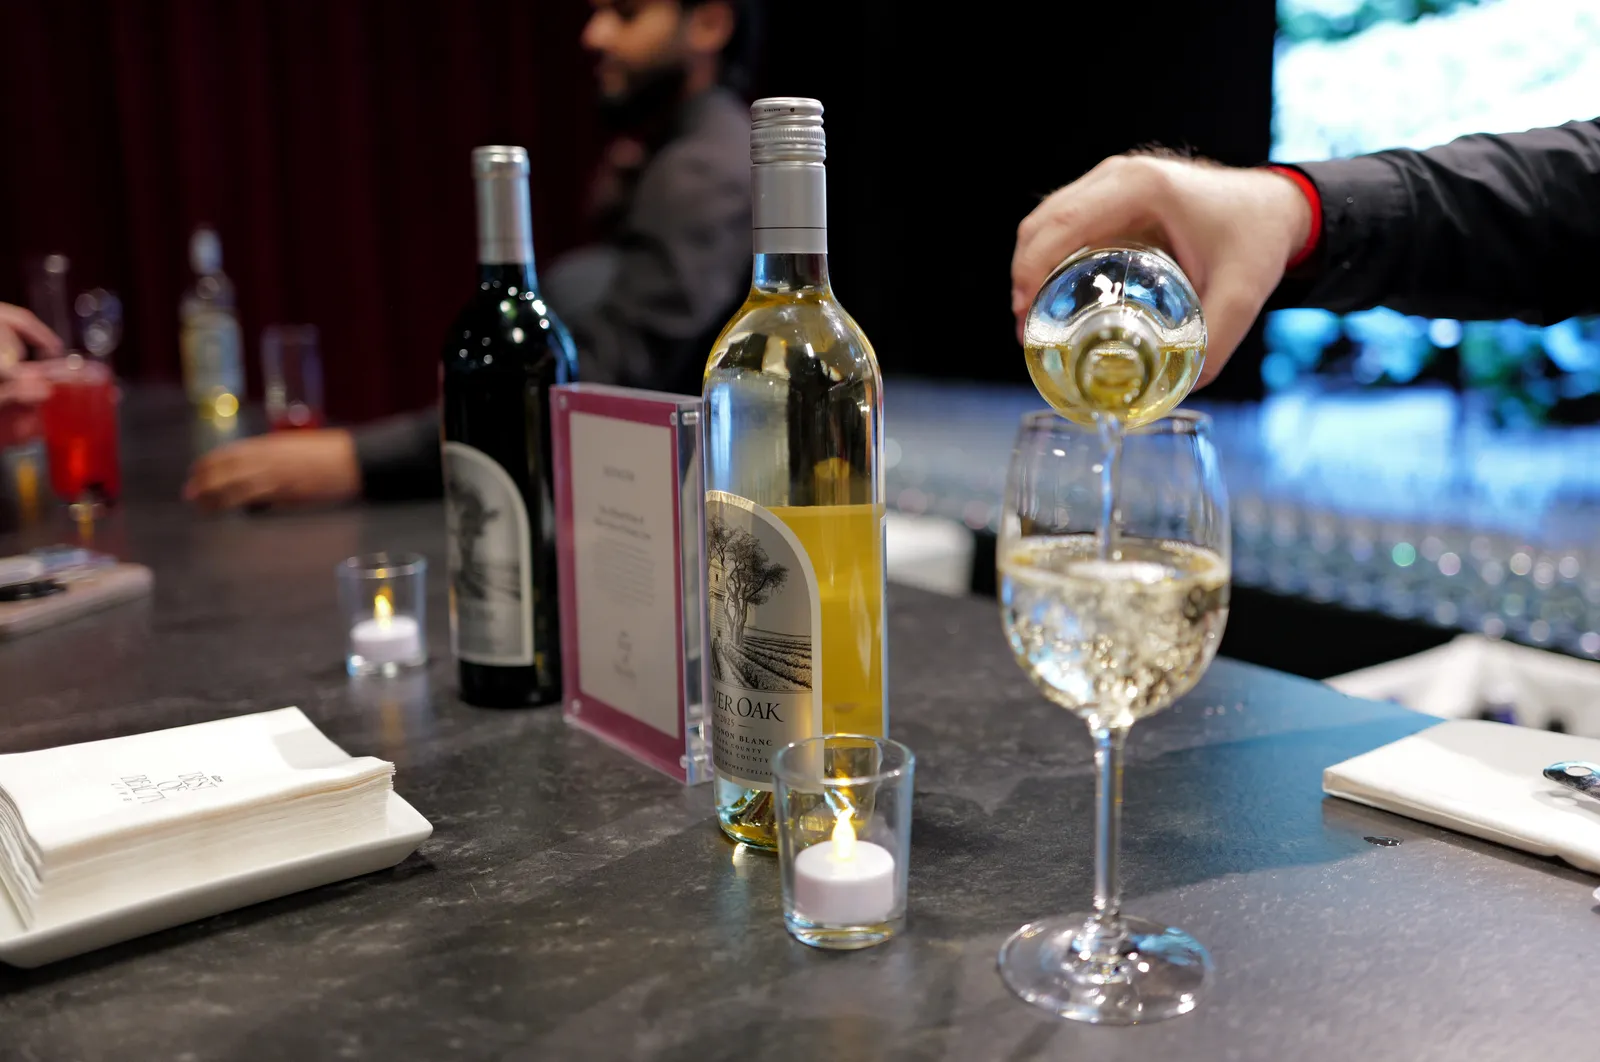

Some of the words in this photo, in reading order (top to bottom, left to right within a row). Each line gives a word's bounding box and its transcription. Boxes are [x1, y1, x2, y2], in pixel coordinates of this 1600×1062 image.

[737, 697, 784, 722] OAK
[739, 735, 773, 747] BLANC
[731, 743, 762, 754] COUNTY
[736, 753, 769, 763] COUNTY
